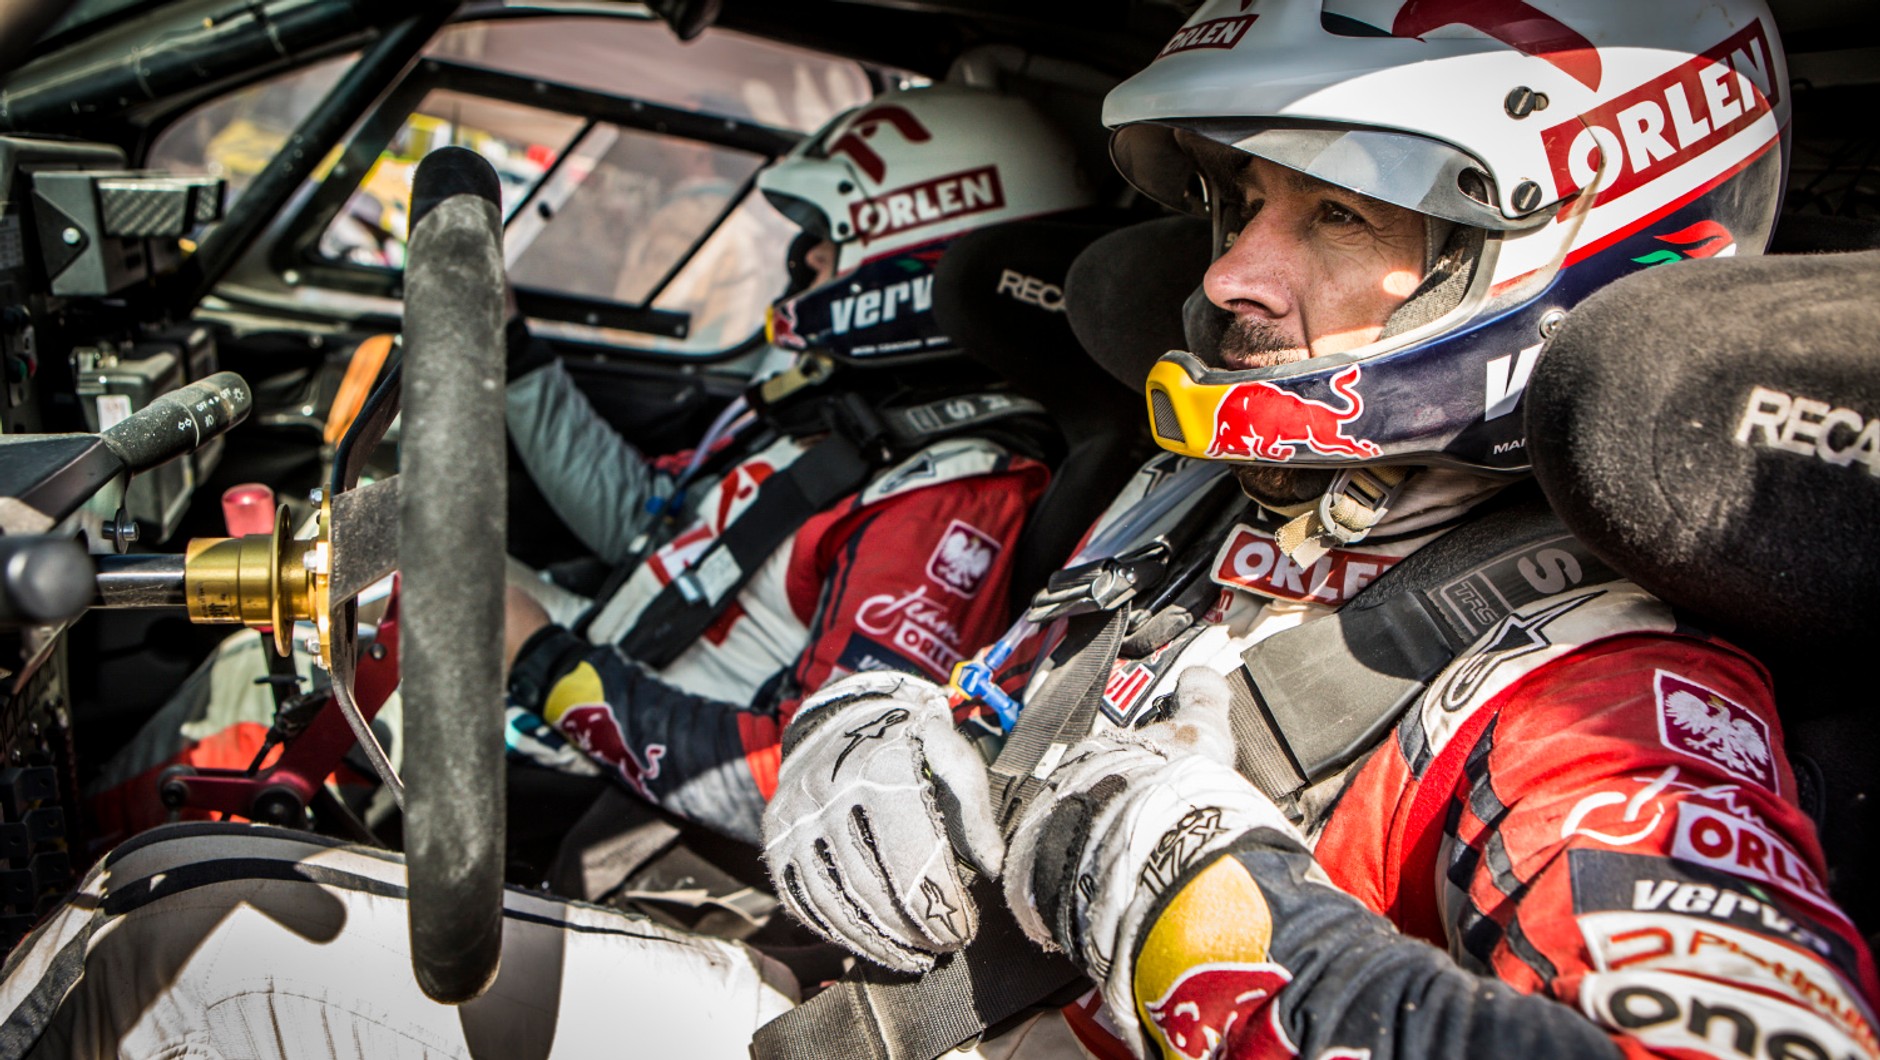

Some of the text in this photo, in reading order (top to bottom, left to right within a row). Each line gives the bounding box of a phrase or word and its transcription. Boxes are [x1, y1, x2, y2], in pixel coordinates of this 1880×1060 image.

[1162, 20, 1248, 55] ORLEN
[1568, 37, 1772, 194] ORLEN
[858, 173, 996, 234] ORLEN
[997, 268, 1066, 311] REC
[1233, 541, 1394, 602] ORLE
[1454, 579, 1500, 626] TRS
[1102, 658, 1156, 712] ull
[1633, 880, 1831, 956] verva
[1609, 986, 1862, 1060] one
